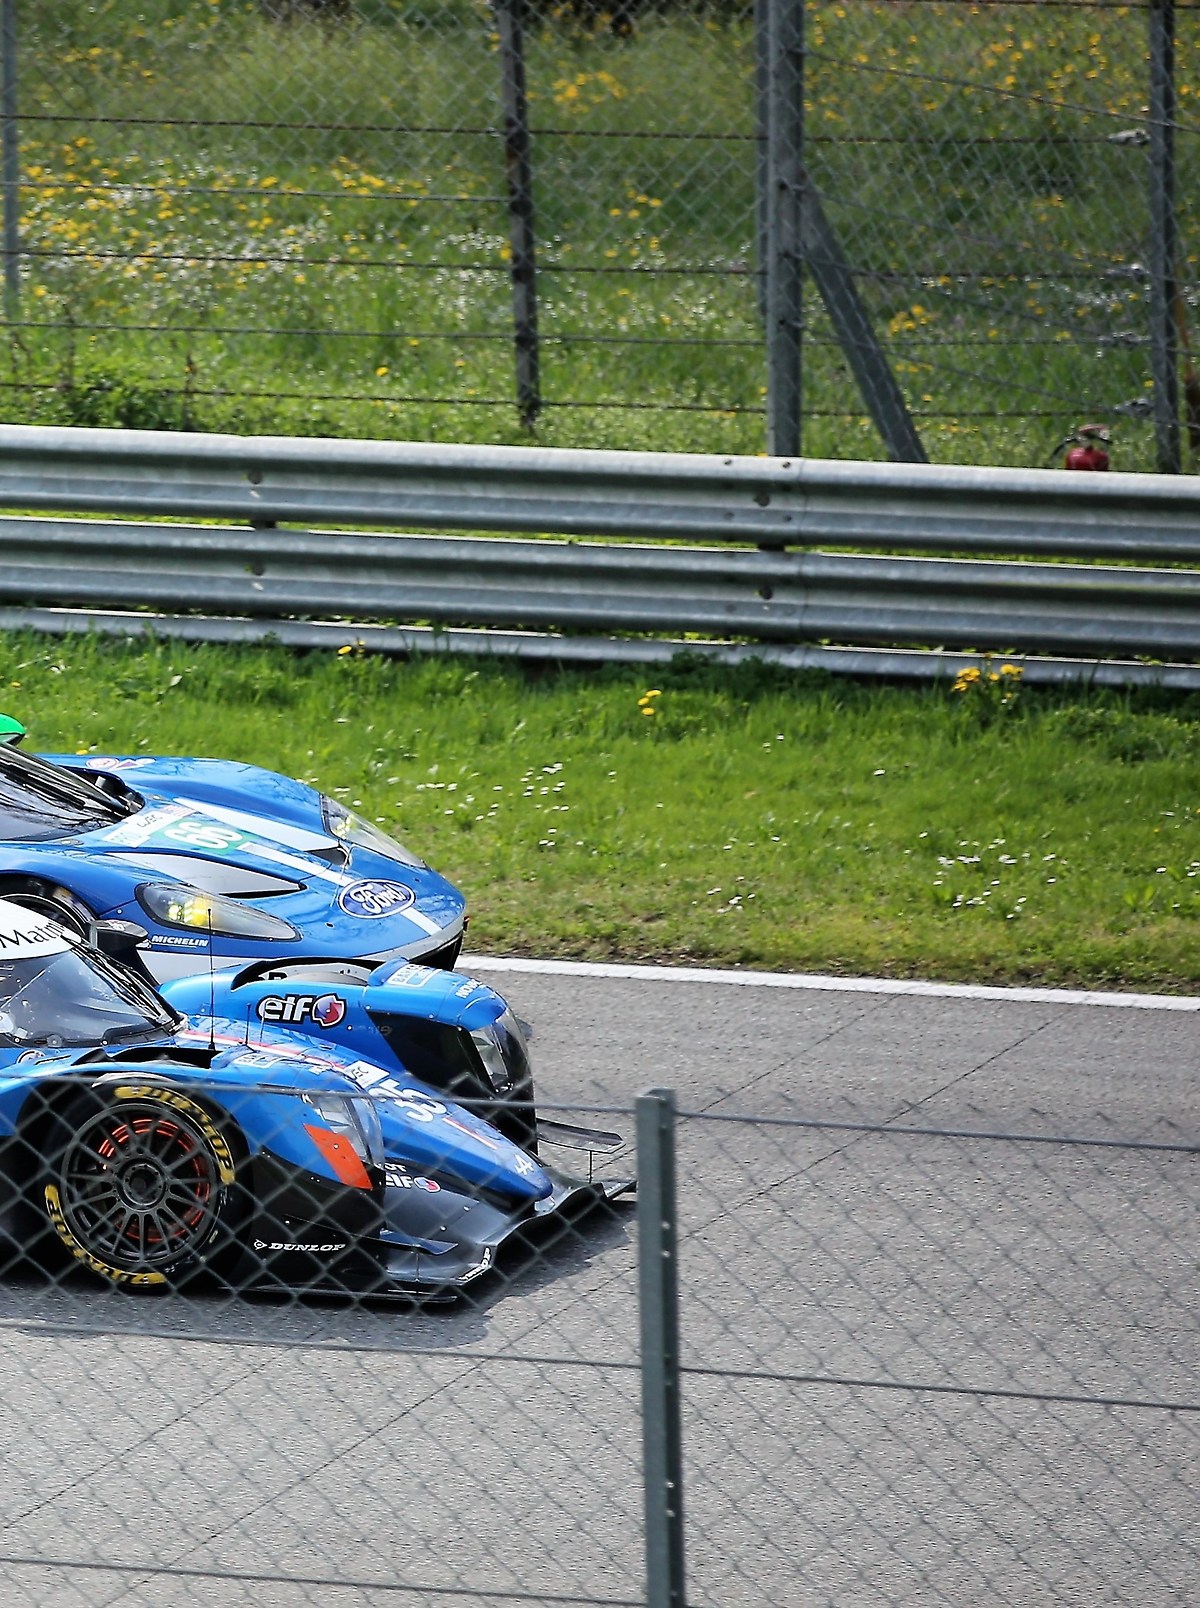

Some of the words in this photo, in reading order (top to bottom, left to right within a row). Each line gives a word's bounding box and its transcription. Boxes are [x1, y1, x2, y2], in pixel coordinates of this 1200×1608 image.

[349, 882, 407, 914] Ford
[151, 935, 209, 947] MICHELIN
[258, 996, 313, 1021] elf
[268, 1243, 347, 1252] DUNLOP
